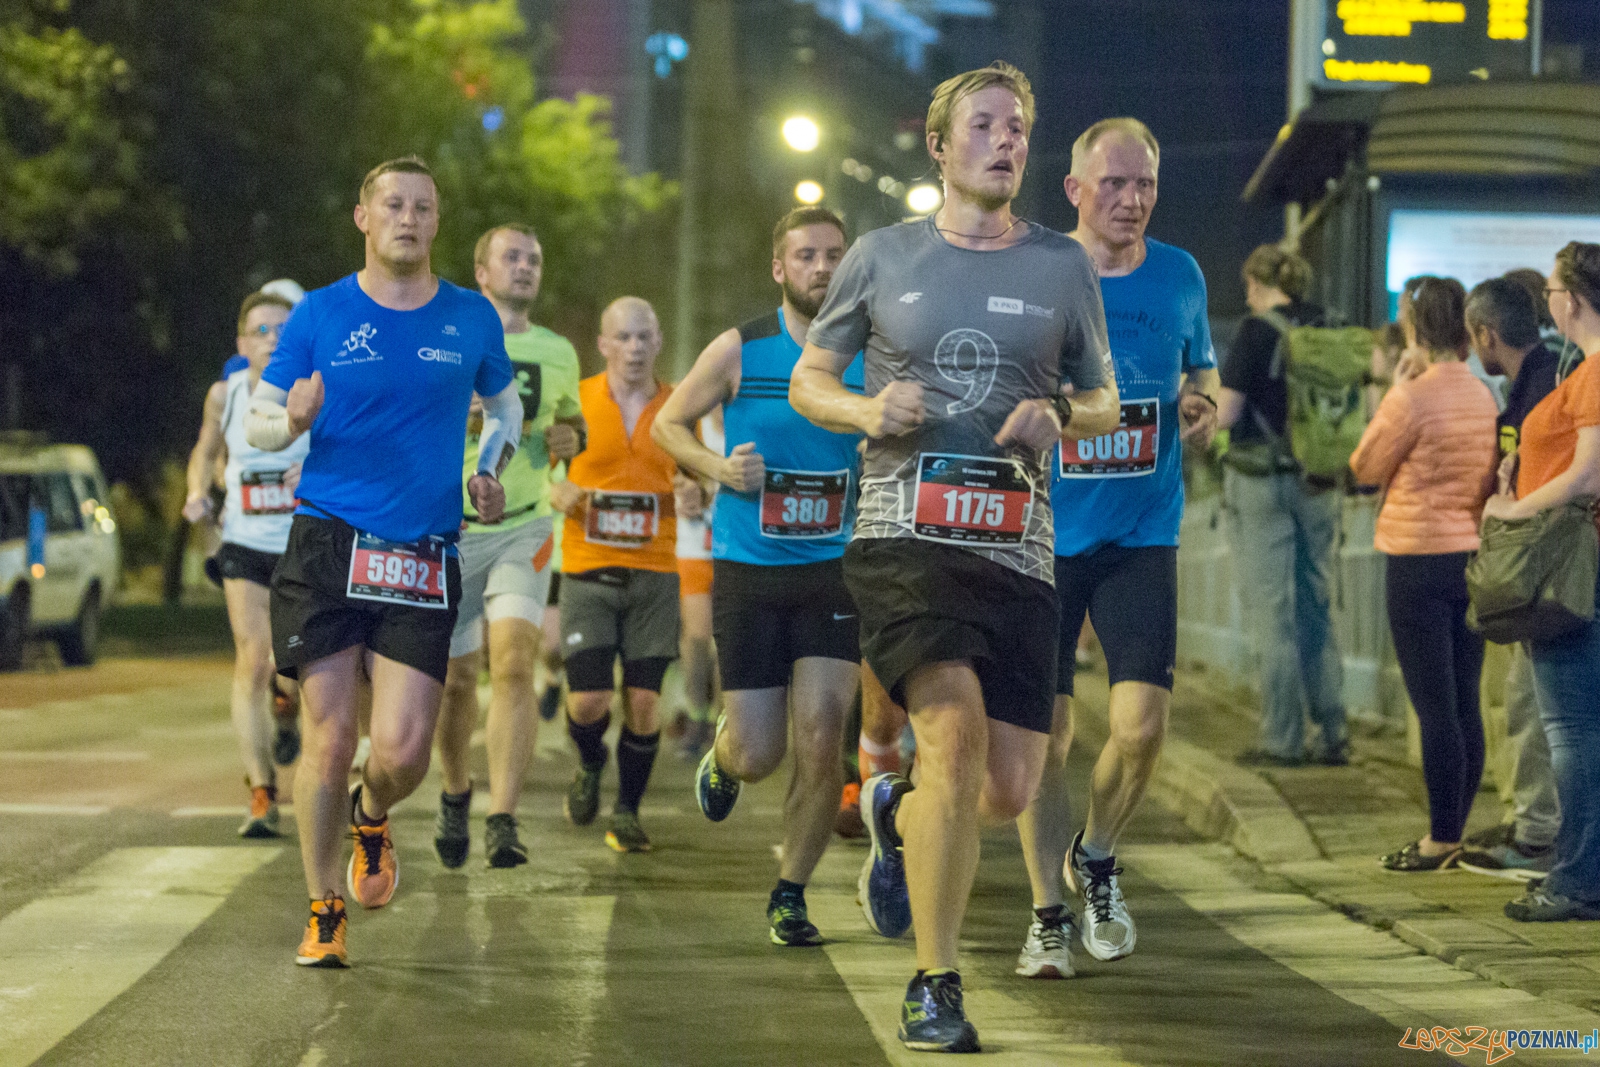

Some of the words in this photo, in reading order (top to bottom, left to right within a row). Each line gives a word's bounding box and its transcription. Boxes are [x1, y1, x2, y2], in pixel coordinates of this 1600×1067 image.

[899, 292, 923, 304] 4F
[934, 328, 999, 415] 9
[1077, 430, 1143, 461] 6087
[782, 496, 829, 524] 380
[942, 489, 1005, 527] 1175
[367, 553, 430, 591] 5932
